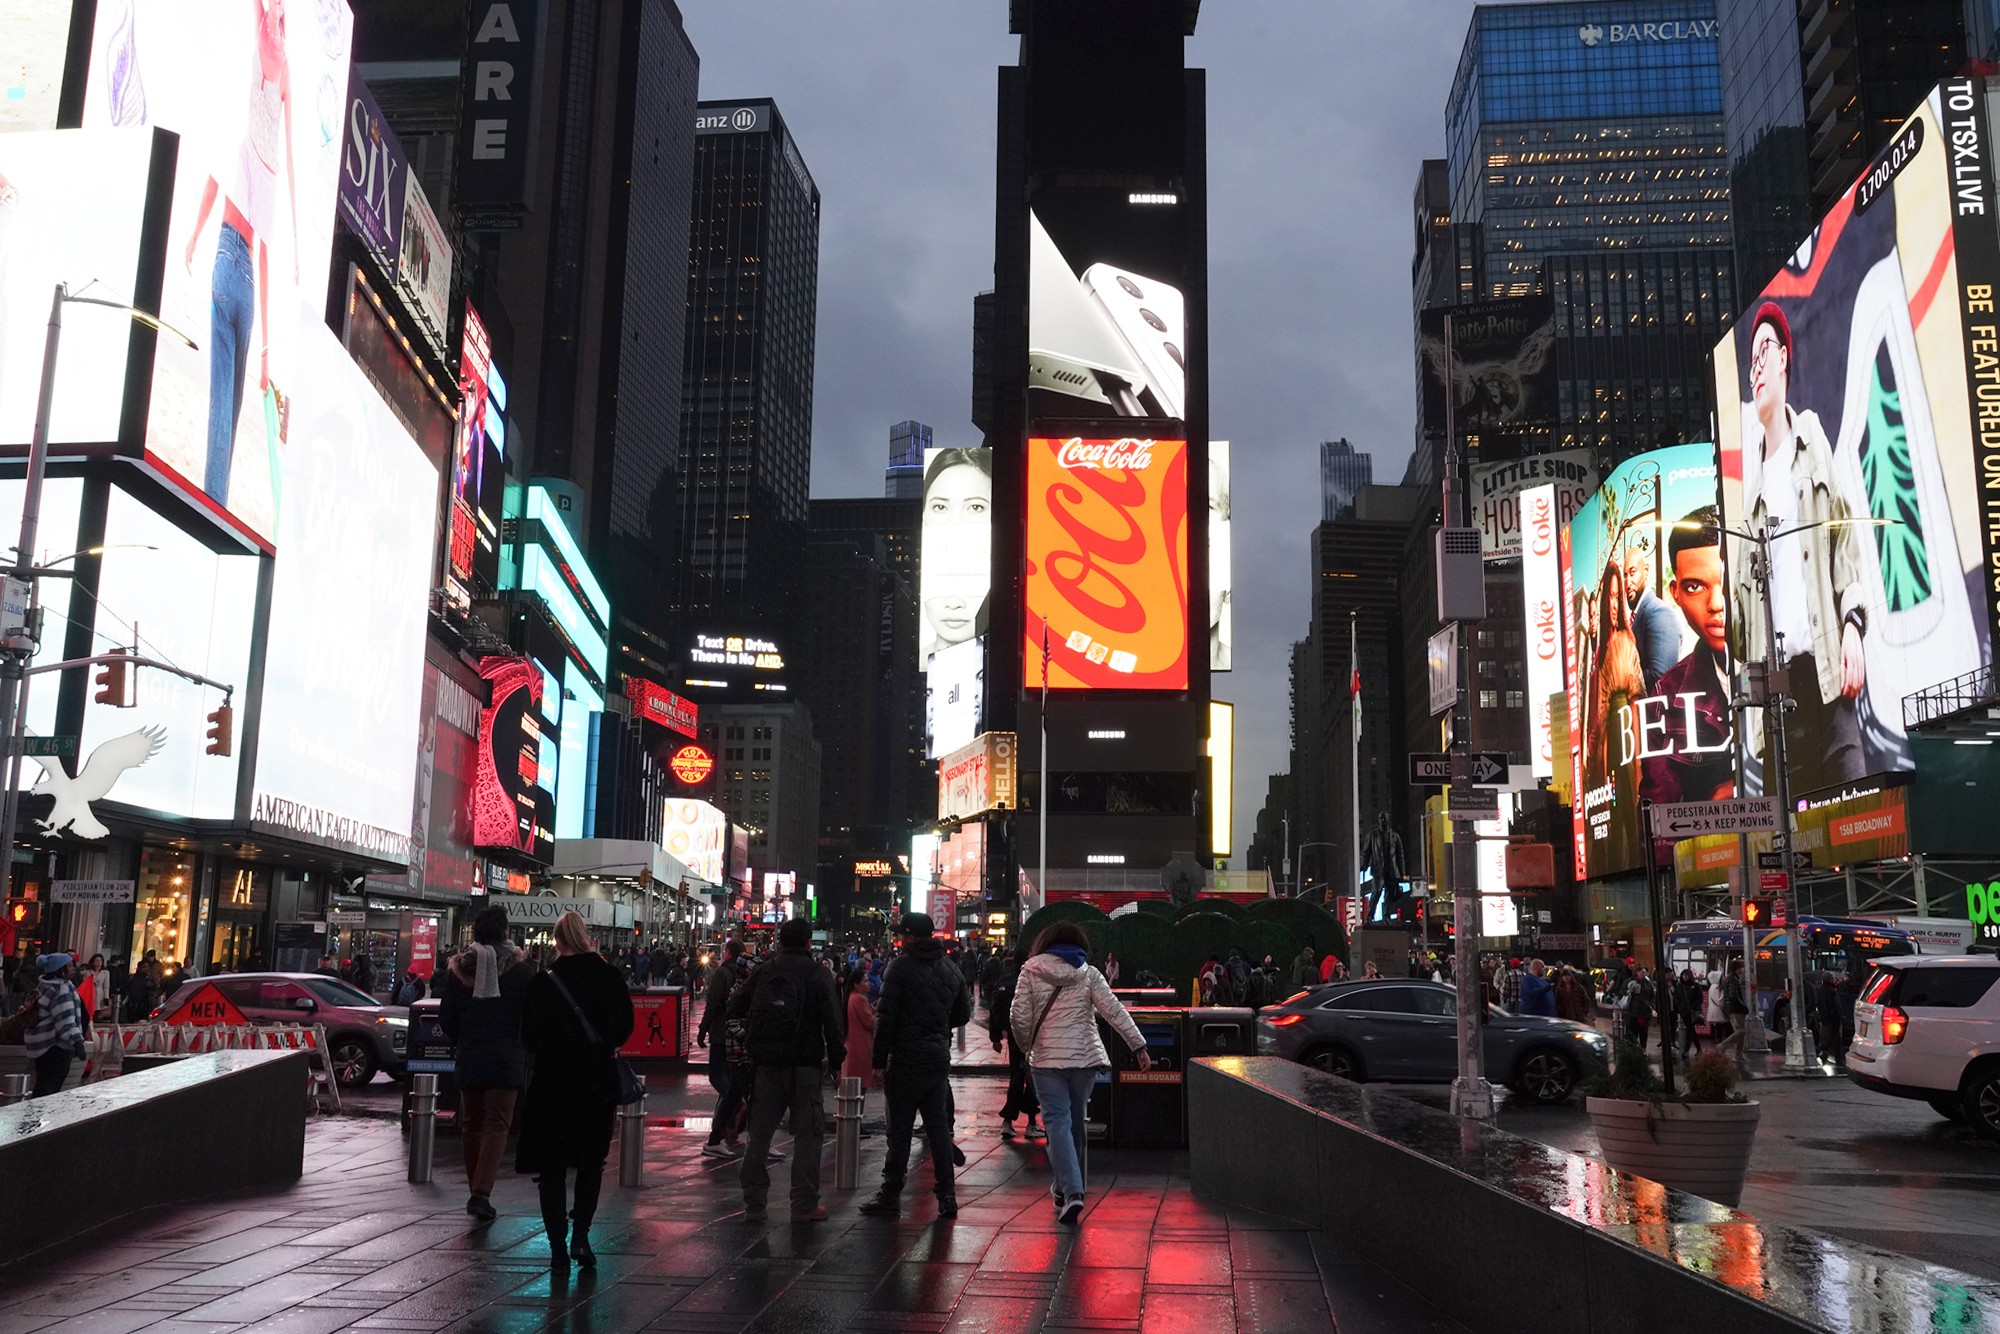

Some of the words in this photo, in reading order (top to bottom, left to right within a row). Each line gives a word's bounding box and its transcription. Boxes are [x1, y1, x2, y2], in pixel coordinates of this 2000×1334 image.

[1948, 80, 1974, 111] TO
[346, 98, 397, 242] SIX
[1860, 130, 1915, 206] 1700.014
[1951, 115, 1984, 216] TSX.LIVE
[1129, 193, 1177, 204] SAMSUNG
[1451, 308, 1466, 317] ON
[1470, 302, 1523, 315] BROADWAY
[1967, 285, 1994, 314] BE
[1487, 315, 1528, 341] Potter
[1971, 325, 2000, 449] FEATURED
[1483, 460, 1540, 497] LITTLE
[1544, 459, 1588, 483] SHOP
[1532, 497, 1553, 557] Coke
[1536, 599, 1557, 660] Coke
[697, 635, 724, 649] Text
[726, 637, 744, 651] OR
[745, 638, 778, 653] Drive.
[691, 649, 725, 663] There
[739, 653, 755, 666] No
[948, 683, 959, 704] all
[1568, 671, 1579, 732] STORE
[1618, 691, 1733, 767] BEL
[26, 740, 38, 753] W
[43, 739, 59, 754] 46
[683, 749, 701, 758] HOT
[995, 737, 1011, 807] HELLO!
[1424, 763, 1450, 775] ONE
[1585, 776, 1613, 819] peacock
[1667, 805, 1720, 818] PEDESTRIAN
[1722, 804, 1746, 814] FLOW
[1749, 802, 1772, 813] ZONE
[255, 793, 324, 837] AMERICAN
[326, 812, 358, 846] EAGLE
[360, 823, 411, 857] OUTFITTERS
[1714, 818, 1736, 829] KEEP
[1739, 816, 1774, 827] MOVING
[1839, 822, 1853, 836] 1568
[1855, 815, 1893, 834] BROADWAY
[1087, 855, 1125, 863] SAMSUNG
[1711, 849, 1734, 862] BROADWAY
[1766, 857, 1781, 865] ONE
[62, 883, 98, 891] PEDESTRIAN
[99, 883, 114, 891] FLOW
[116, 883, 130, 891] ZONE
[933, 894, 950, 929] tkts
[191, 1002, 226, 1018] MEN
[1121, 1073, 1147, 1081] TIMES
